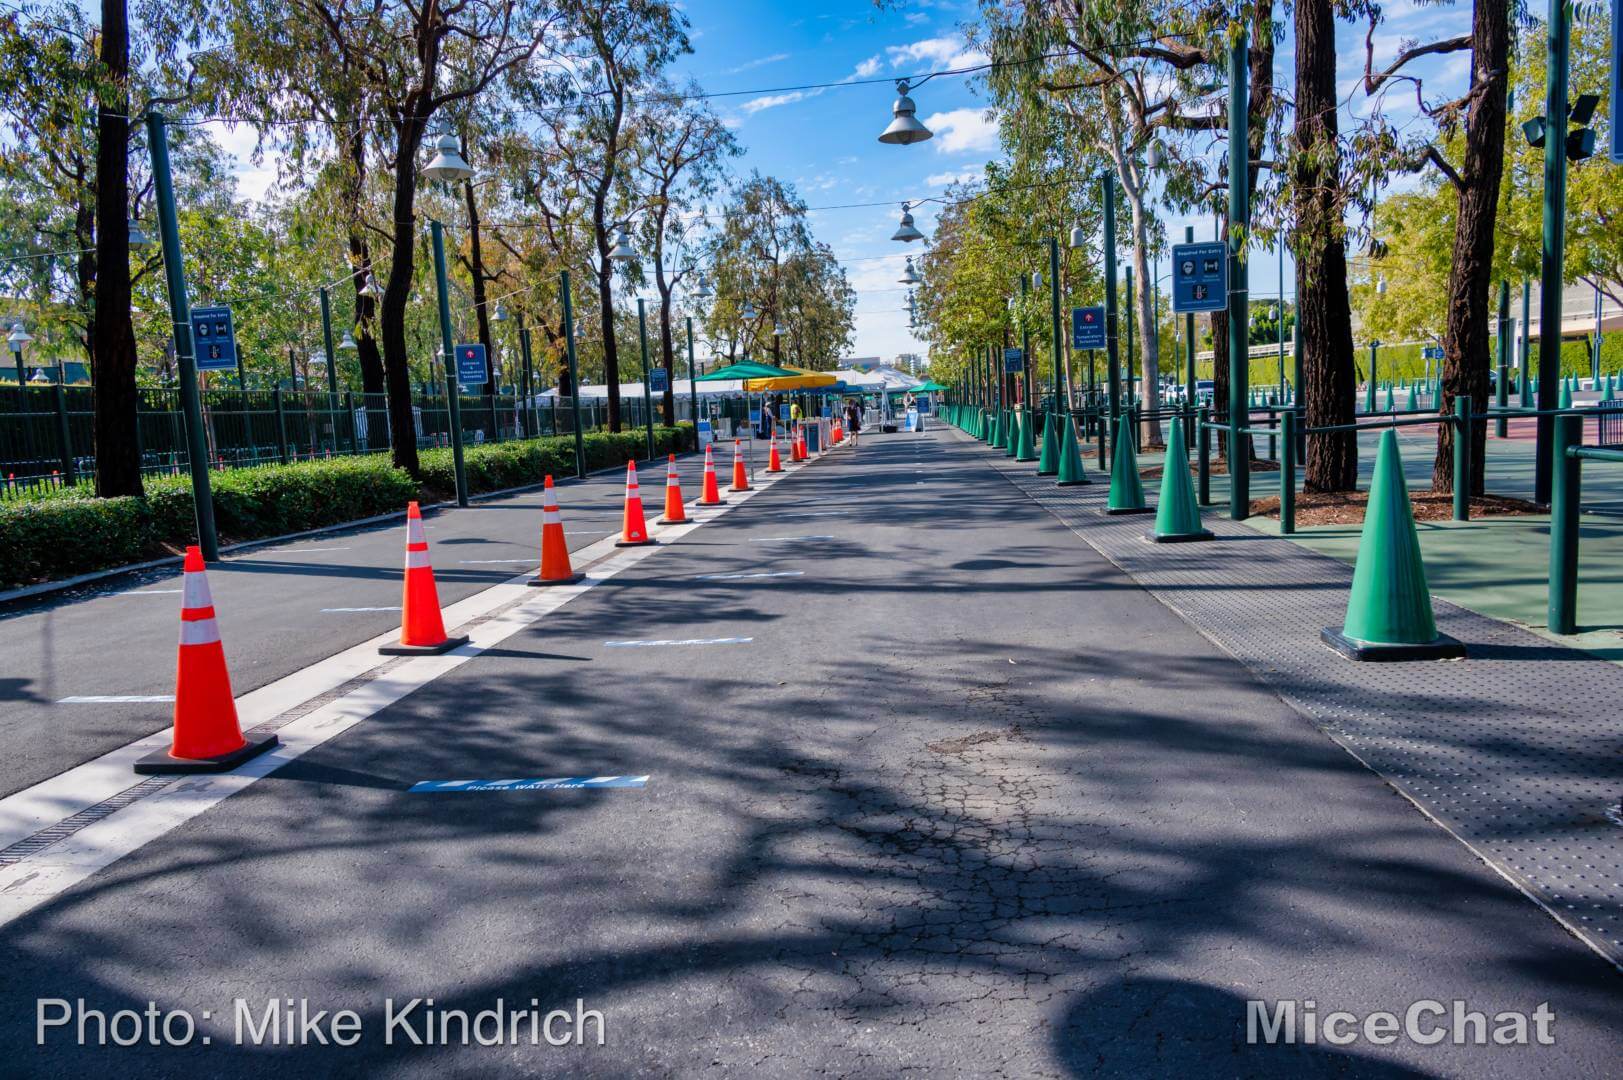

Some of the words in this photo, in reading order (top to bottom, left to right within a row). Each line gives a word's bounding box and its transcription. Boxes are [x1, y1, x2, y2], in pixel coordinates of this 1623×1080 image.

[466, 784, 511, 792] Please
[514, 783, 548, 791] WAIT
[552, 782, 586, 790] Here
